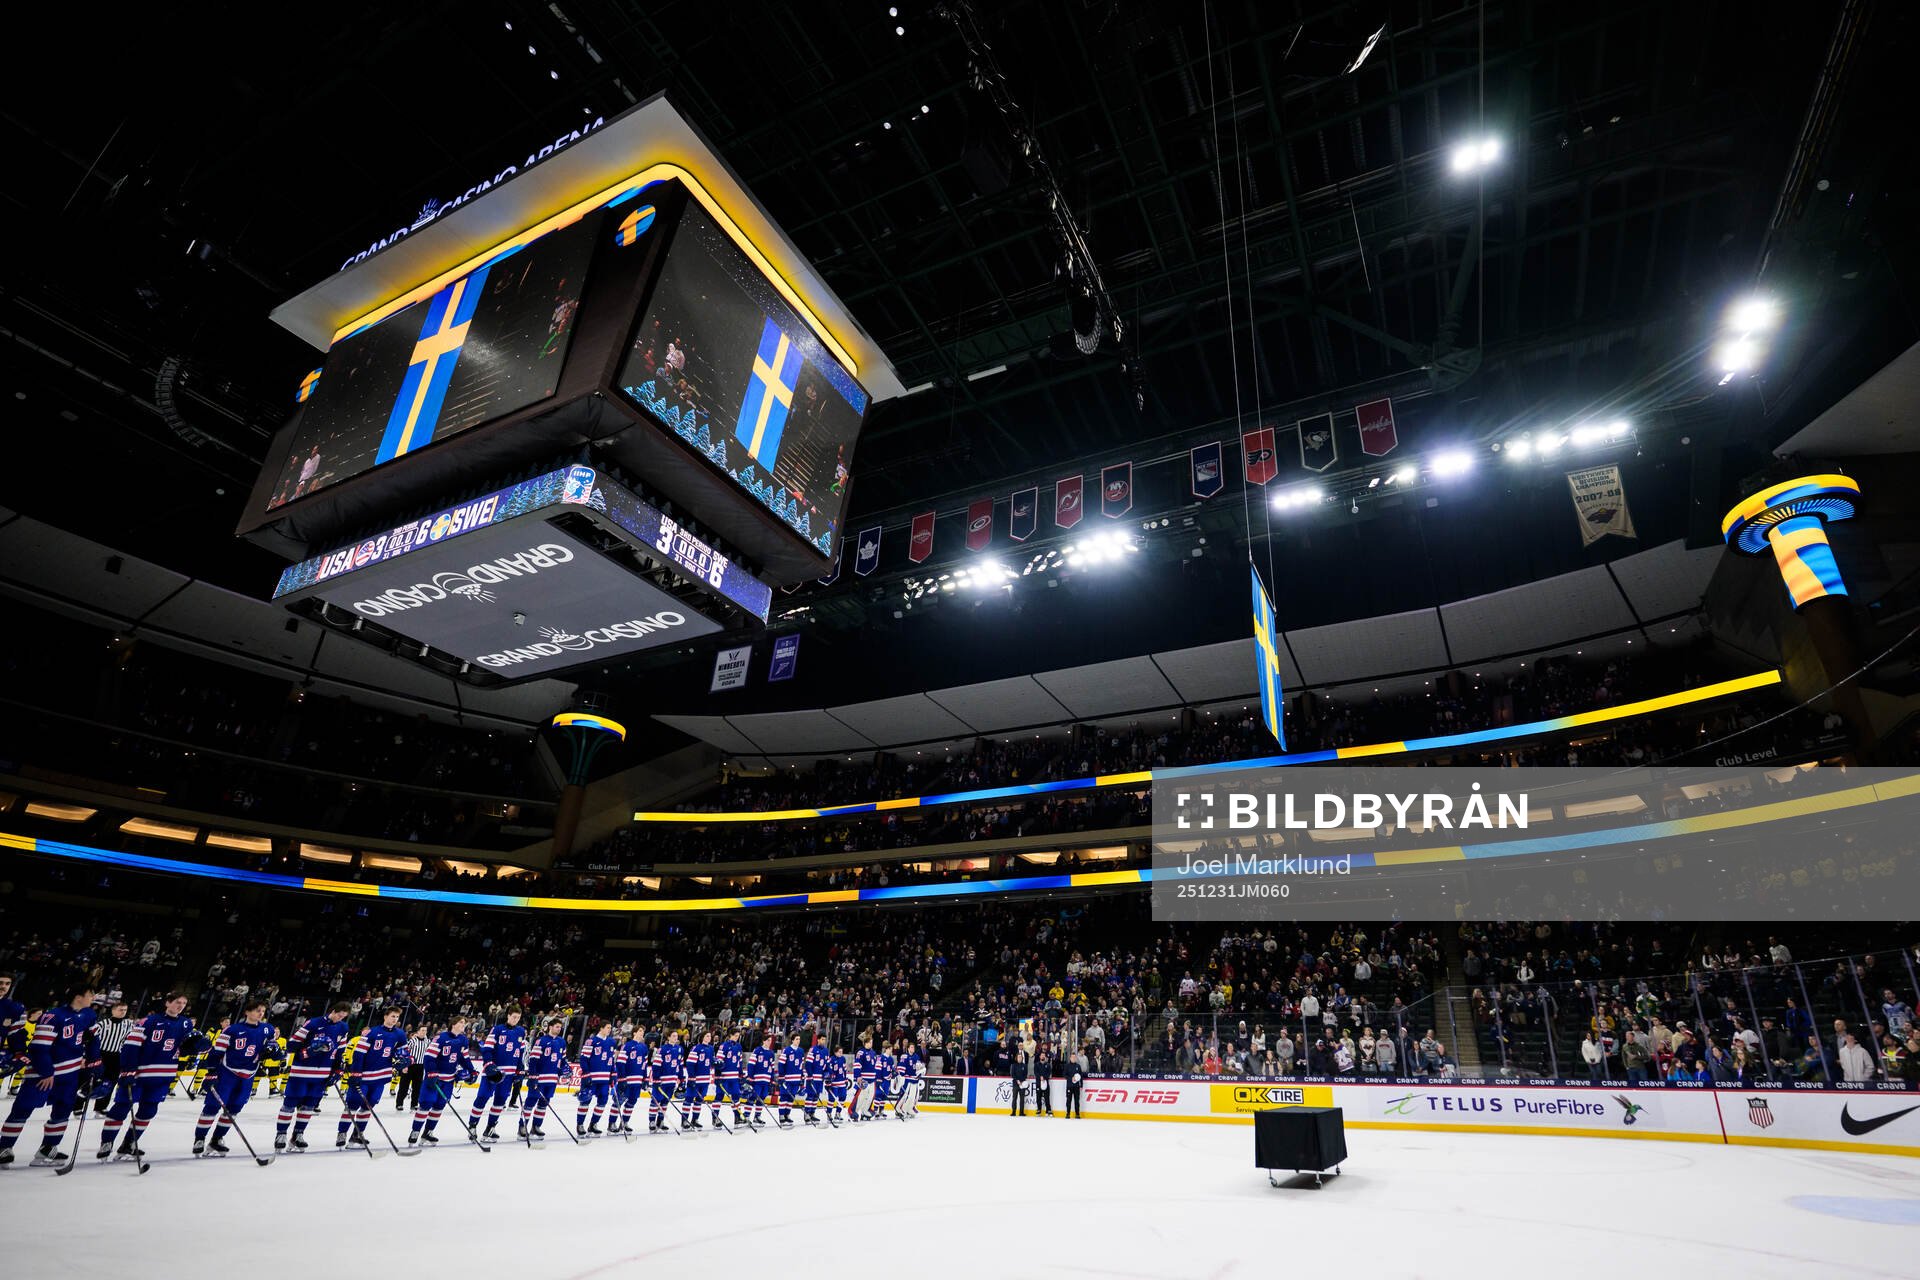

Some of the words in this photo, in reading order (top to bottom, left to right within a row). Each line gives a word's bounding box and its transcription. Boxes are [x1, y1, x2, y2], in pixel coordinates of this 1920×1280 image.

[1575, 488, 1621, 503] 2007-08
[416, 520, 432, 545] 6
[451, 498, 494, 534] SWE
[661, 514, 678, 534] USA
[656, 525, 674, 555] 3
[679, 540, 707, 568] 00.0
[319, 548, 354, 579] USA
[371, 535, 388, 560] 3
[466, 543, 574, 584] GRAND
[713, 550, 728, 569] SWE
[709, 560, 725, 589] 6
[353, 583, 447, 617] CASINO
[476, 642, 563, 667] GRAND
[584, 611, 686, 643] CASINO
[1715, 752, 1743, 767] Club
[1745, 746, 1778, 762] Level
[1085, 1089, 1128, 1103] TSN
[1234, 1087, 1269, 1103] OK
[1272, 1090, 1302, 1102] TIRE
[1427, 1097, 1503, 1112] TELUS
[1514, 1099, 1604, 1115] PureFibre
